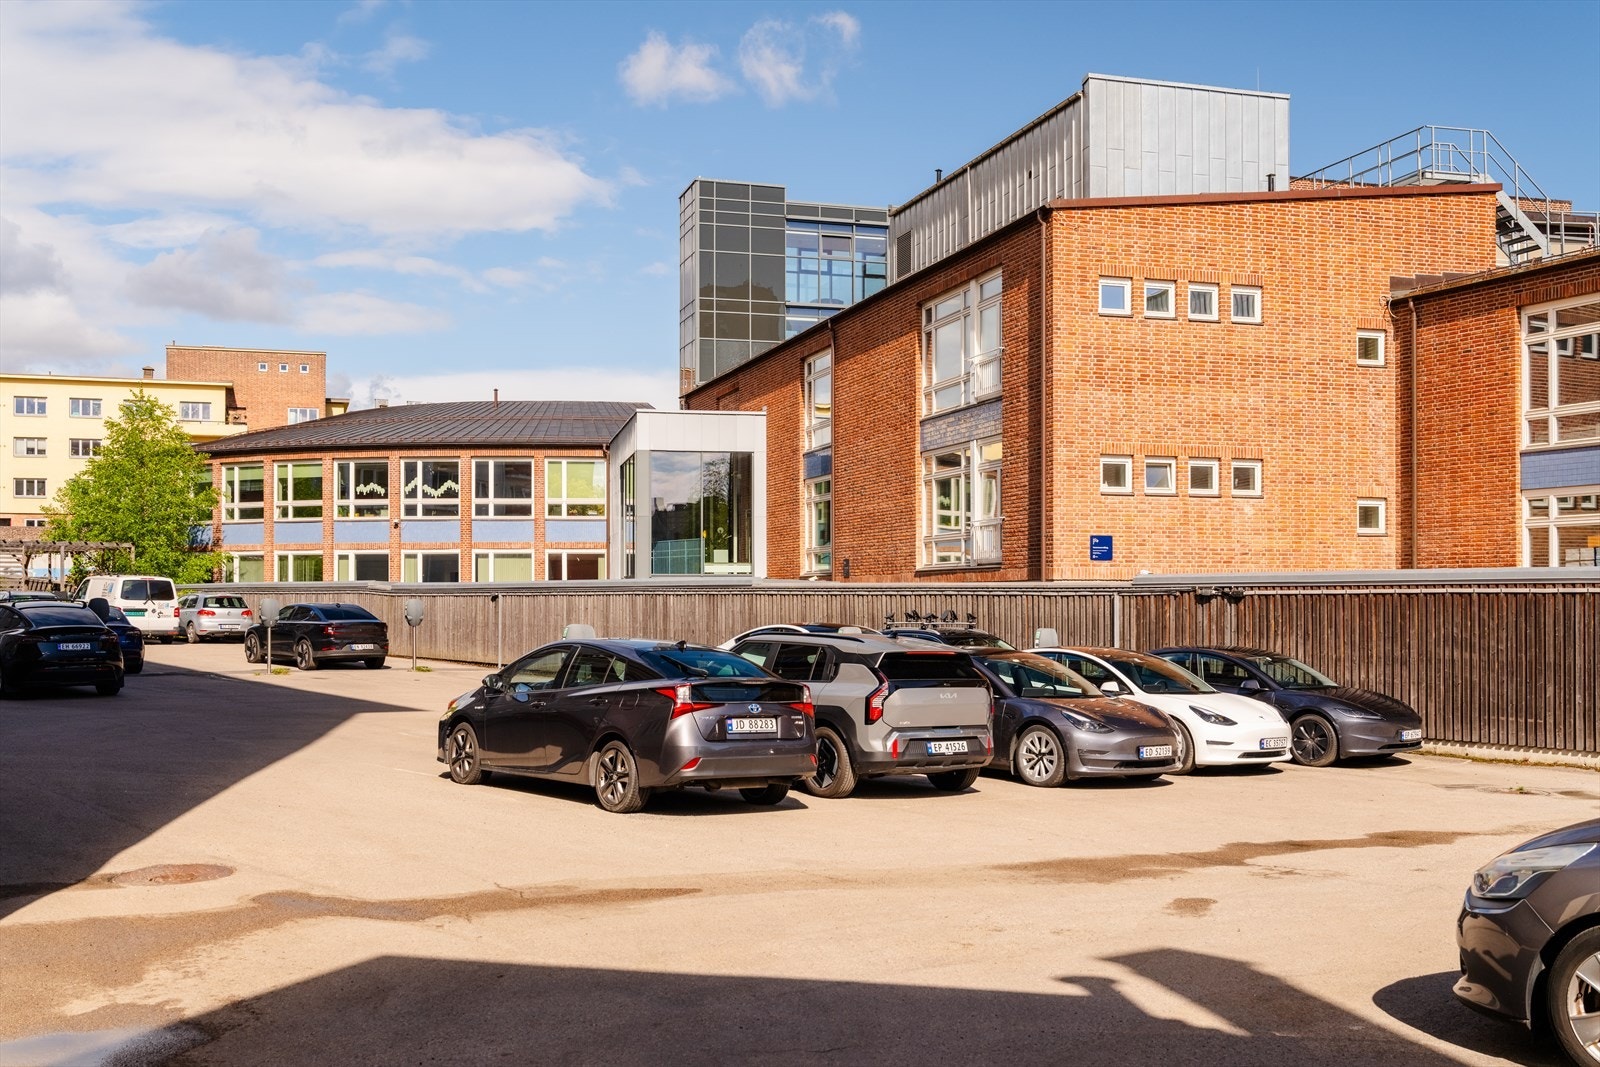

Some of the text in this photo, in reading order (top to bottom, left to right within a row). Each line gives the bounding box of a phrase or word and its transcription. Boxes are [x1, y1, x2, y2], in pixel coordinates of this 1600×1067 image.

[735, 718, 774, 730] JD 88283
[933, 742, 966, 752] EP 41526
